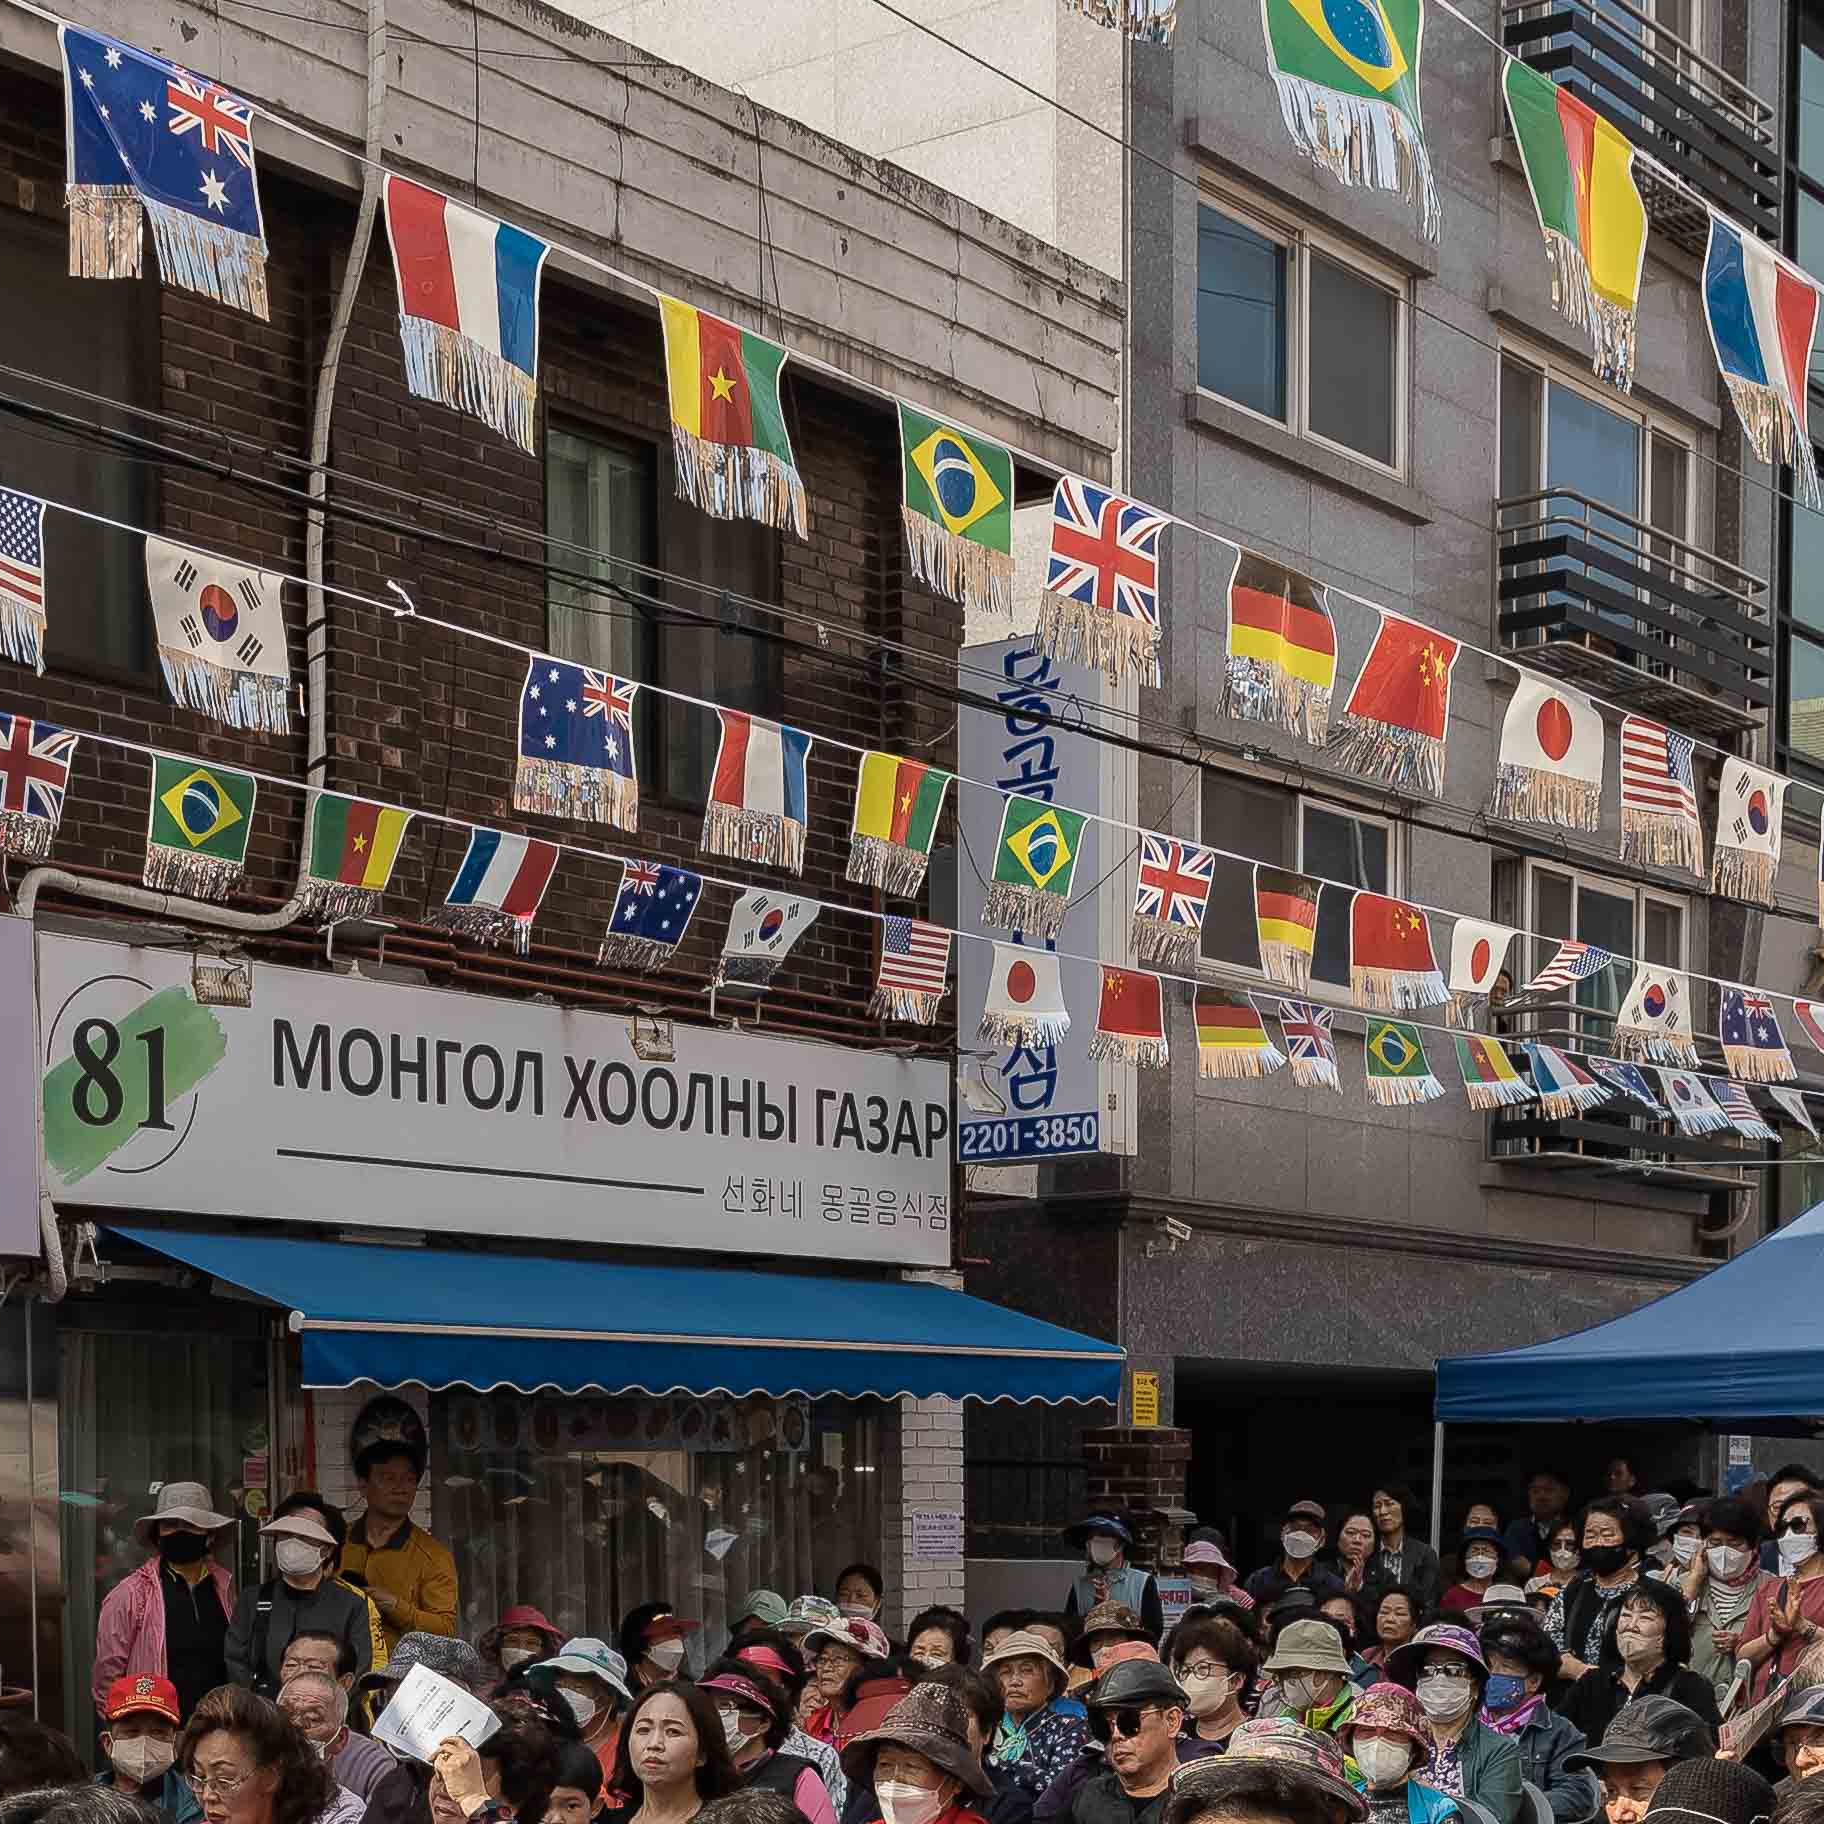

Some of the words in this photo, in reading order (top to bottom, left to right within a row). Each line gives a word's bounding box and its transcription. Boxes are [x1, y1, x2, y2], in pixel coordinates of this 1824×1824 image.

[71, 1016, 177, 1132] 81
[272, 1018, 544, 1118] МОНГОЛ
[563, 1053, 798, 1146] ХООЛНЫ
[815, 1088, 948, 1159] ГАЗАР
[962, 1116, 1097, 1154] 2201-3850
[722, 1176, 802, 1218] 선화네
[822, 1184, 948, 1230] 몽골음식점
